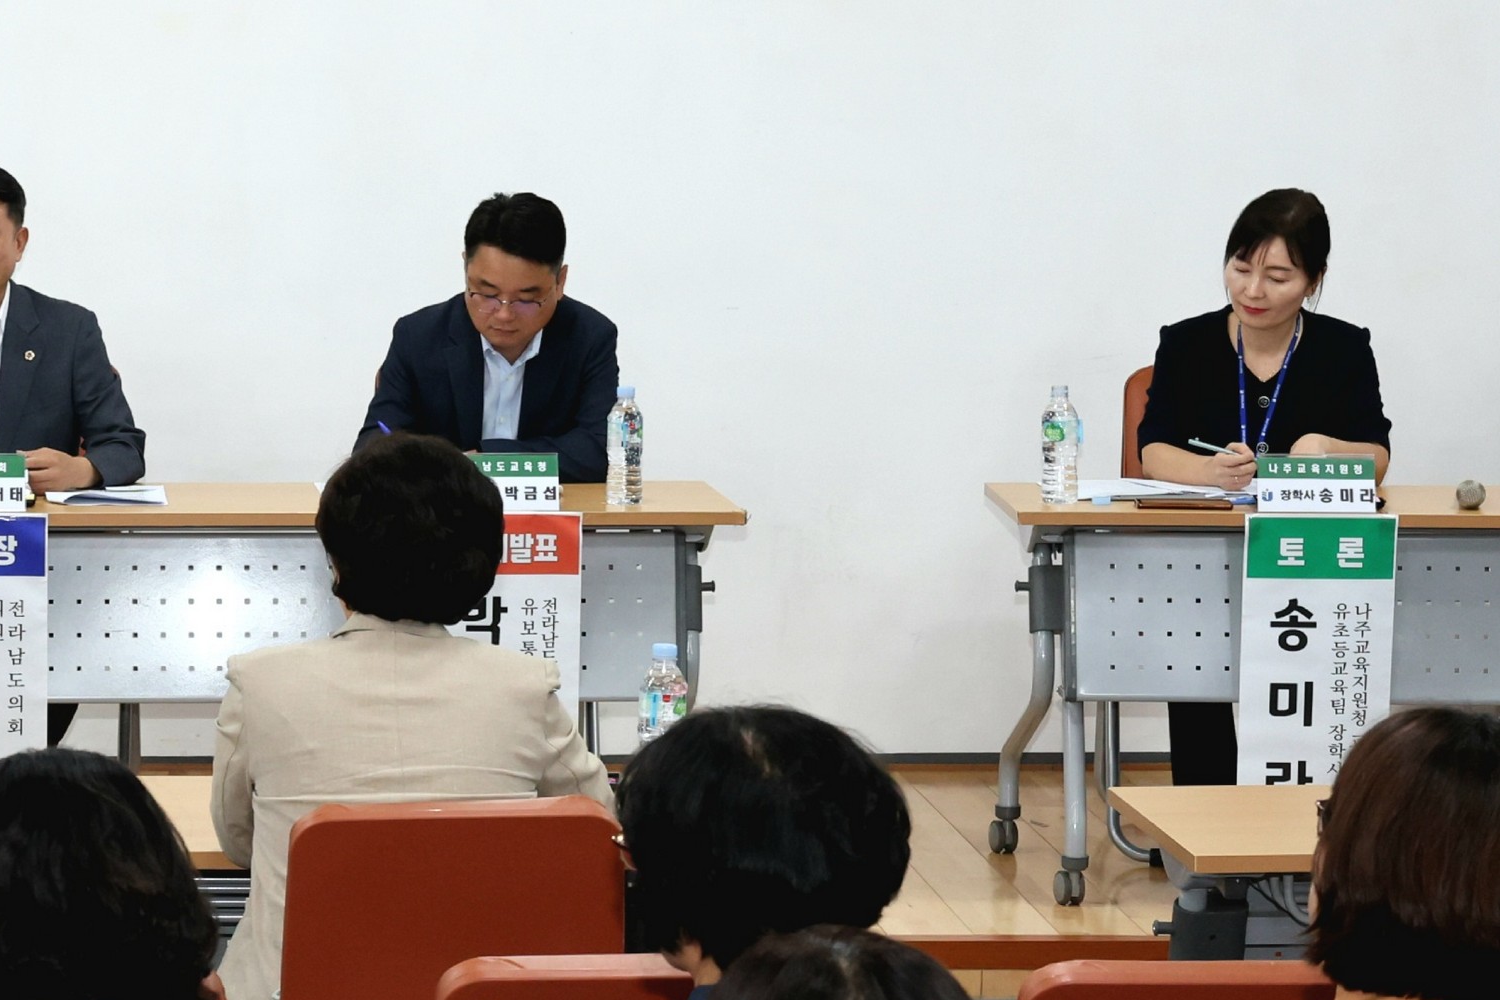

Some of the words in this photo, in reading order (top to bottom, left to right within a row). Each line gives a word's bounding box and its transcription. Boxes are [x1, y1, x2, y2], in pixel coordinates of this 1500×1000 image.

[475, 461, 548, 473] 남도교육청
[1267, 462, 1364, 475] 나주교육지원청
[504, 485, 558, 501] 박금섭
[1280, 489, 1316, 501] 장학사
[1318, 487, 1376, 504] 송미라
[501, 532, 559, 564] 발표
[7, 599, 27, 737] 전라남도의회
[1329, 602, 1351, 716] 유초등교육팀
[1351, 602, 1373, 728] 나주교육지원청
